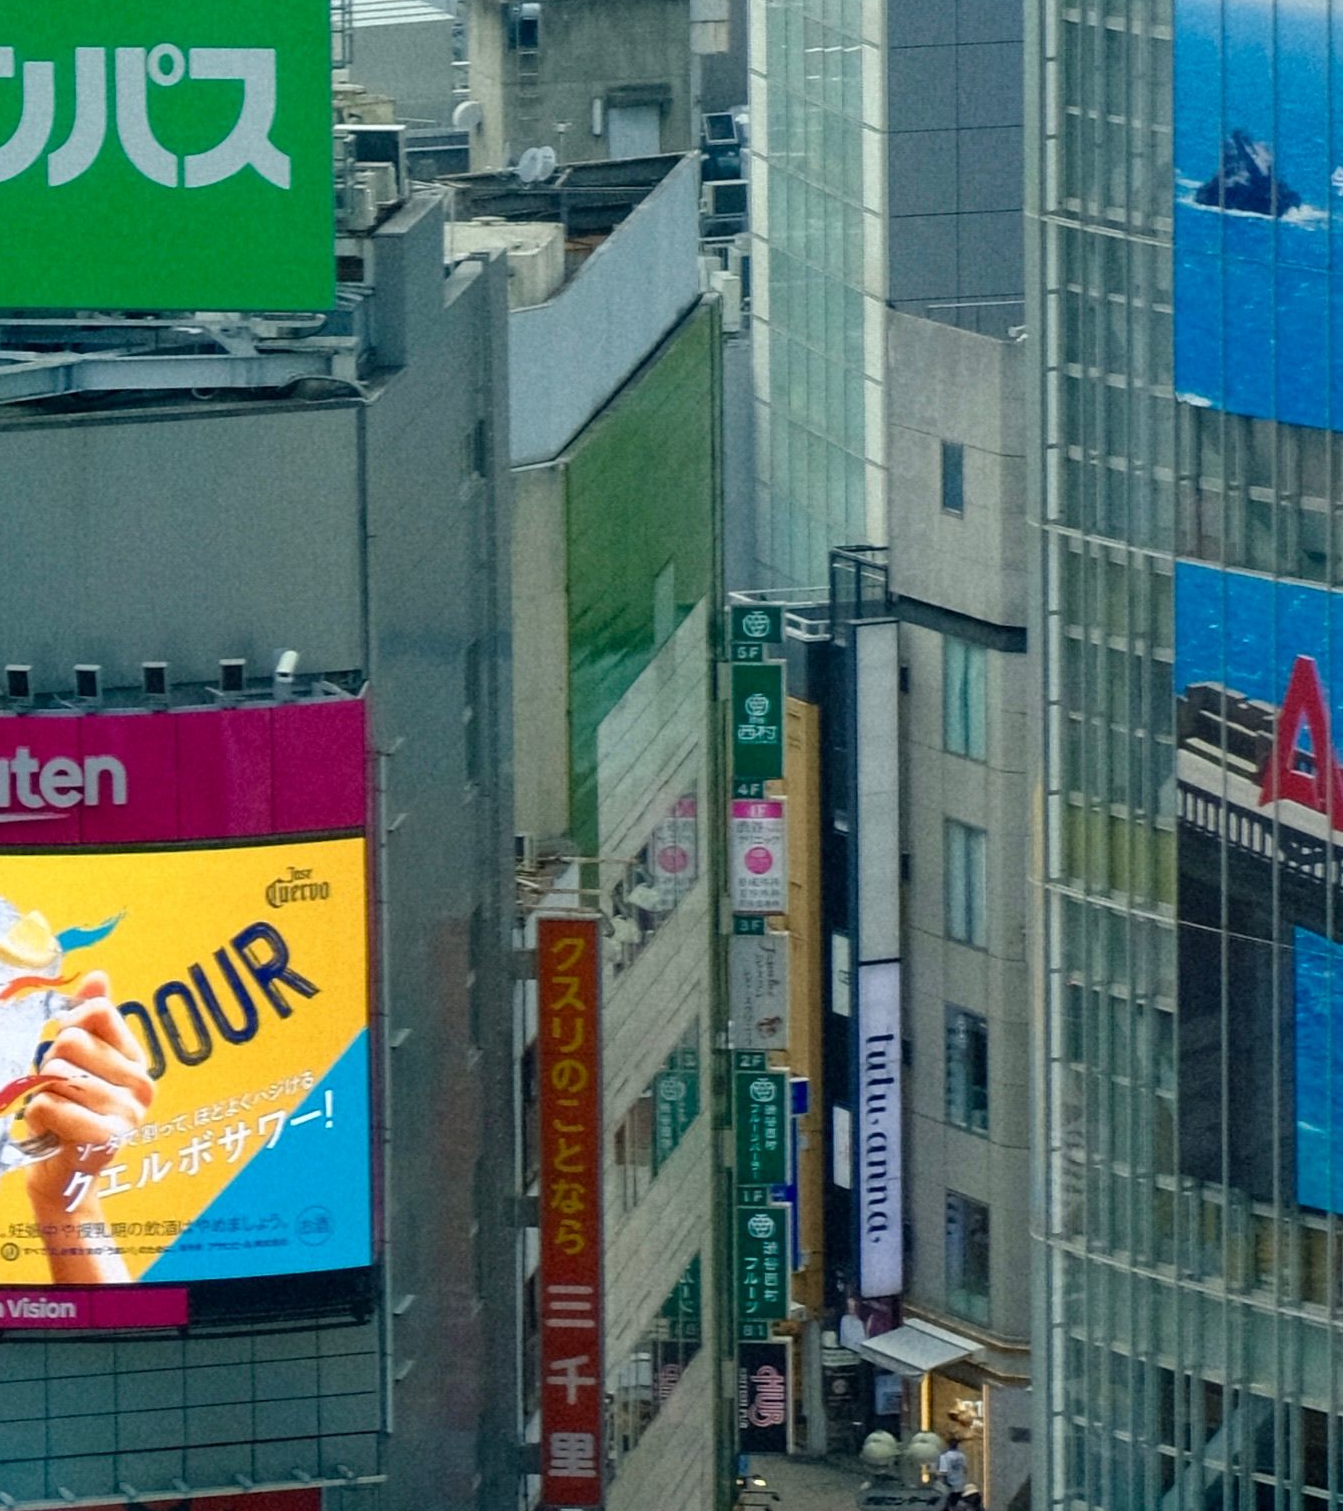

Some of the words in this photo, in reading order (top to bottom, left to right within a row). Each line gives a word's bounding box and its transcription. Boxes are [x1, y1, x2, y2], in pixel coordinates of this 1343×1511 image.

[266, 876, 331, 911] Cuervo
[550, 936, 587, 1255] クスリのことなら
[63, 1092, 336, 1215] クエルボサワー！
[7, 1296, 76, 1320] Vision
[545, 1285, 597, 1478] 三千里
[748, 1365, 786, 1427] HUB
